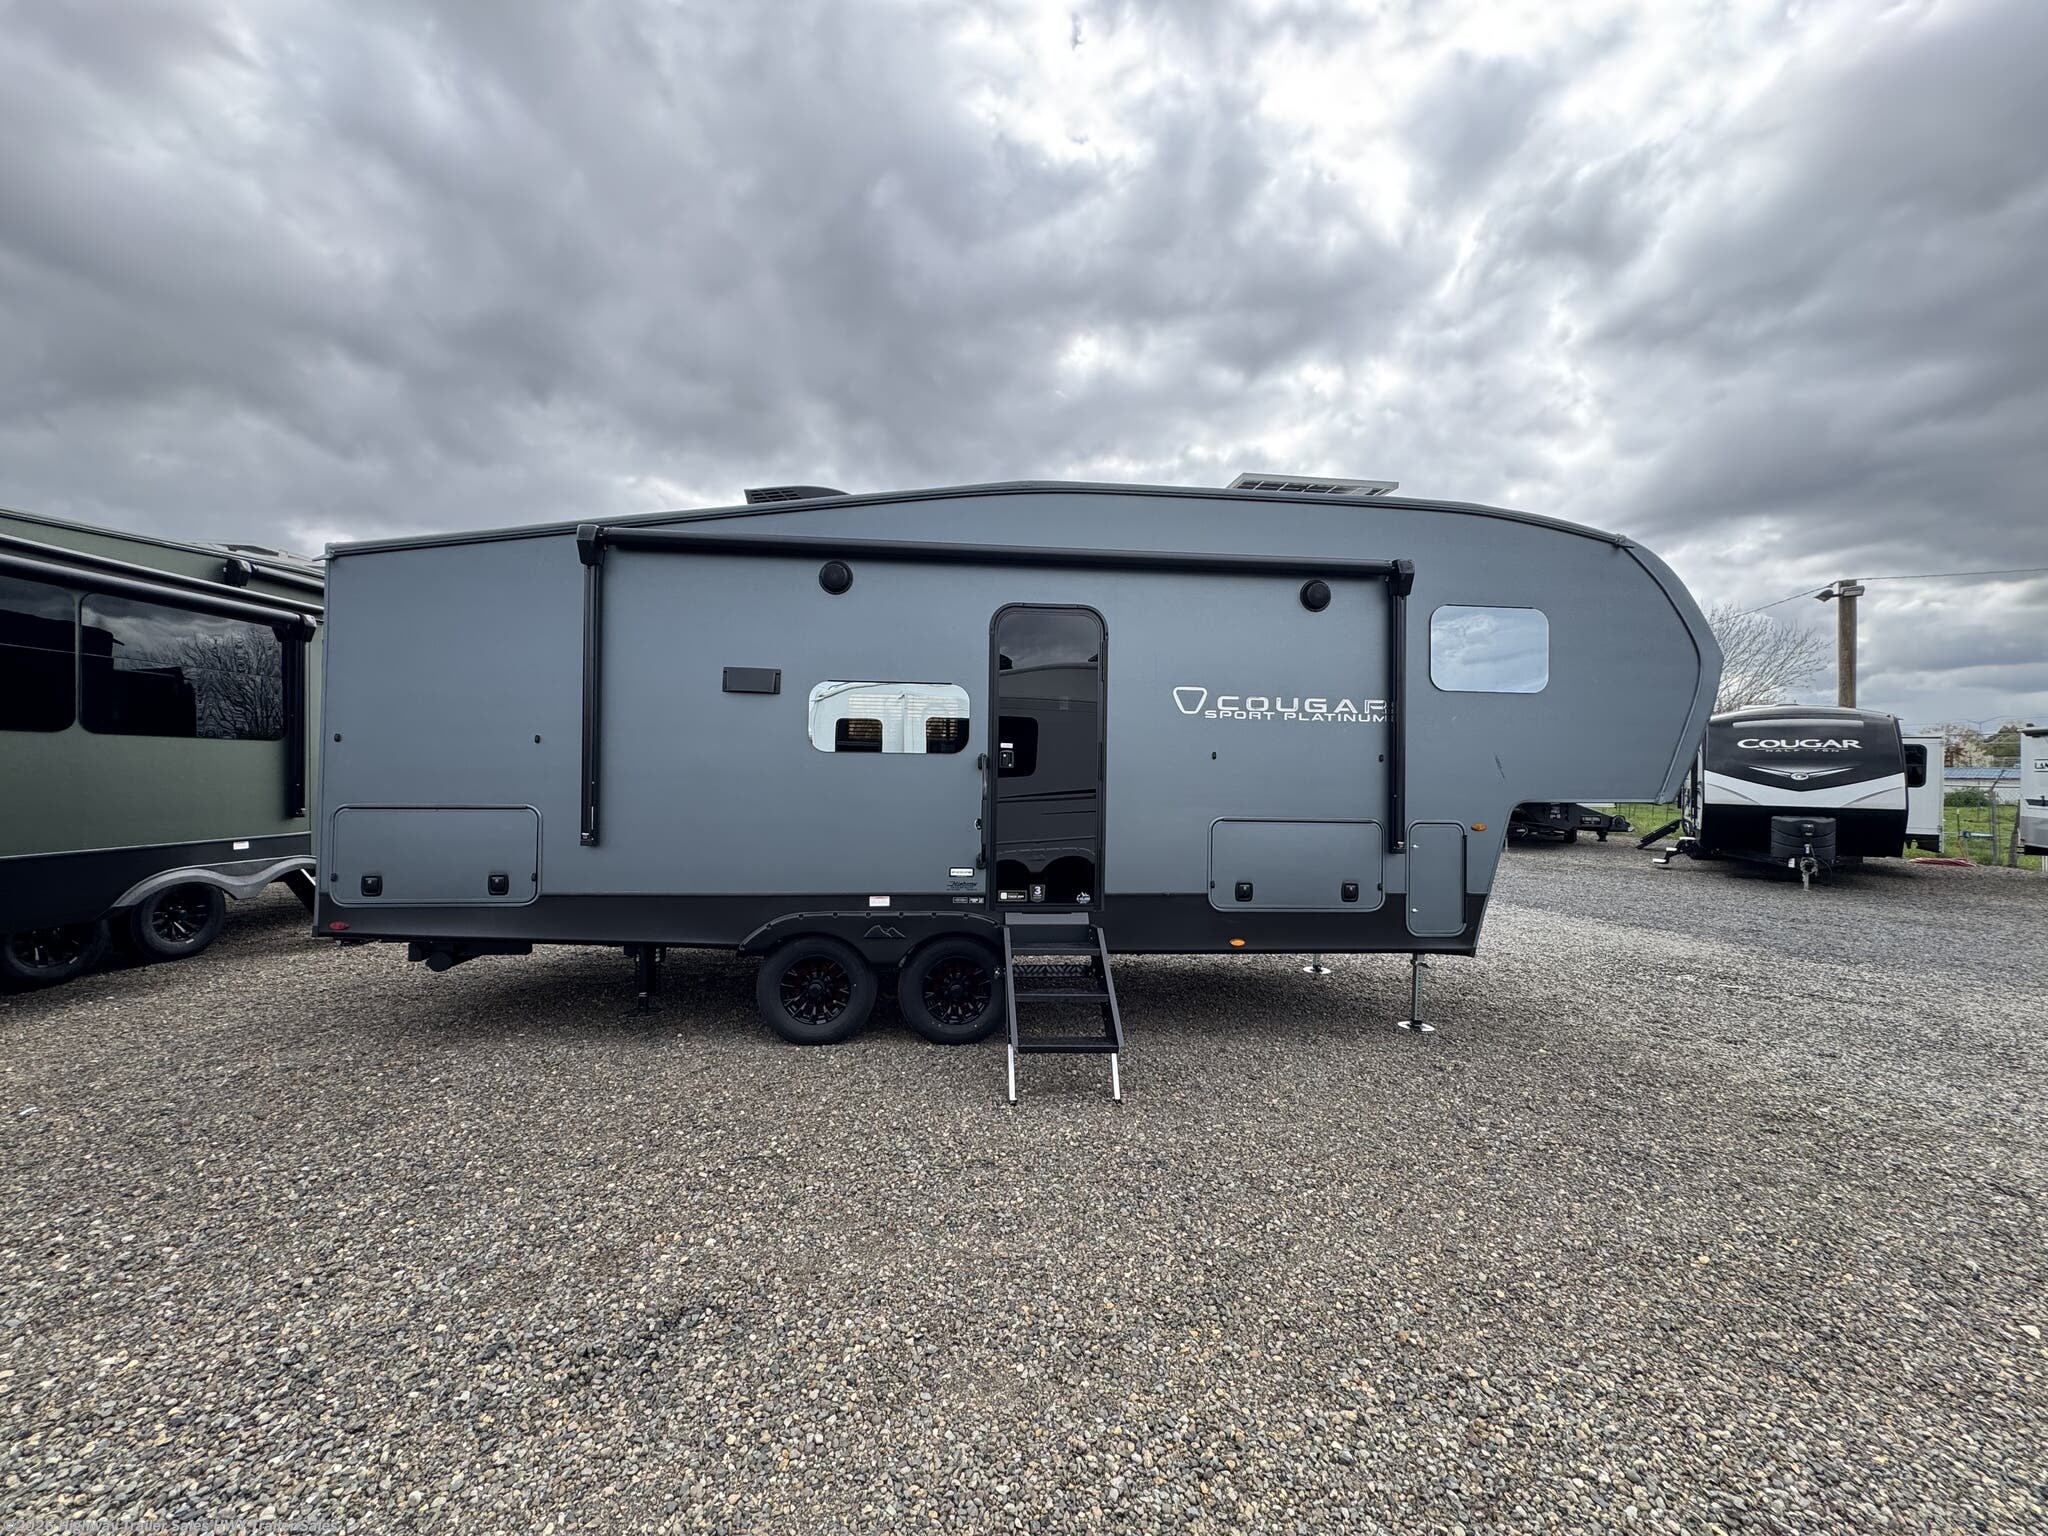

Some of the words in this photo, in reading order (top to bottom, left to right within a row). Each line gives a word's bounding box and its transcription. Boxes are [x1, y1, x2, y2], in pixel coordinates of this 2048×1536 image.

[1217, 696, 1387, 714] COUGAR
[1204, 710, 1275, 720] SPORT
[1283, 712, 1388, 723] PLATINUM
[1737, 738, 1863, 749] COUGAR
[1033, 886, 1041, 895] 3
